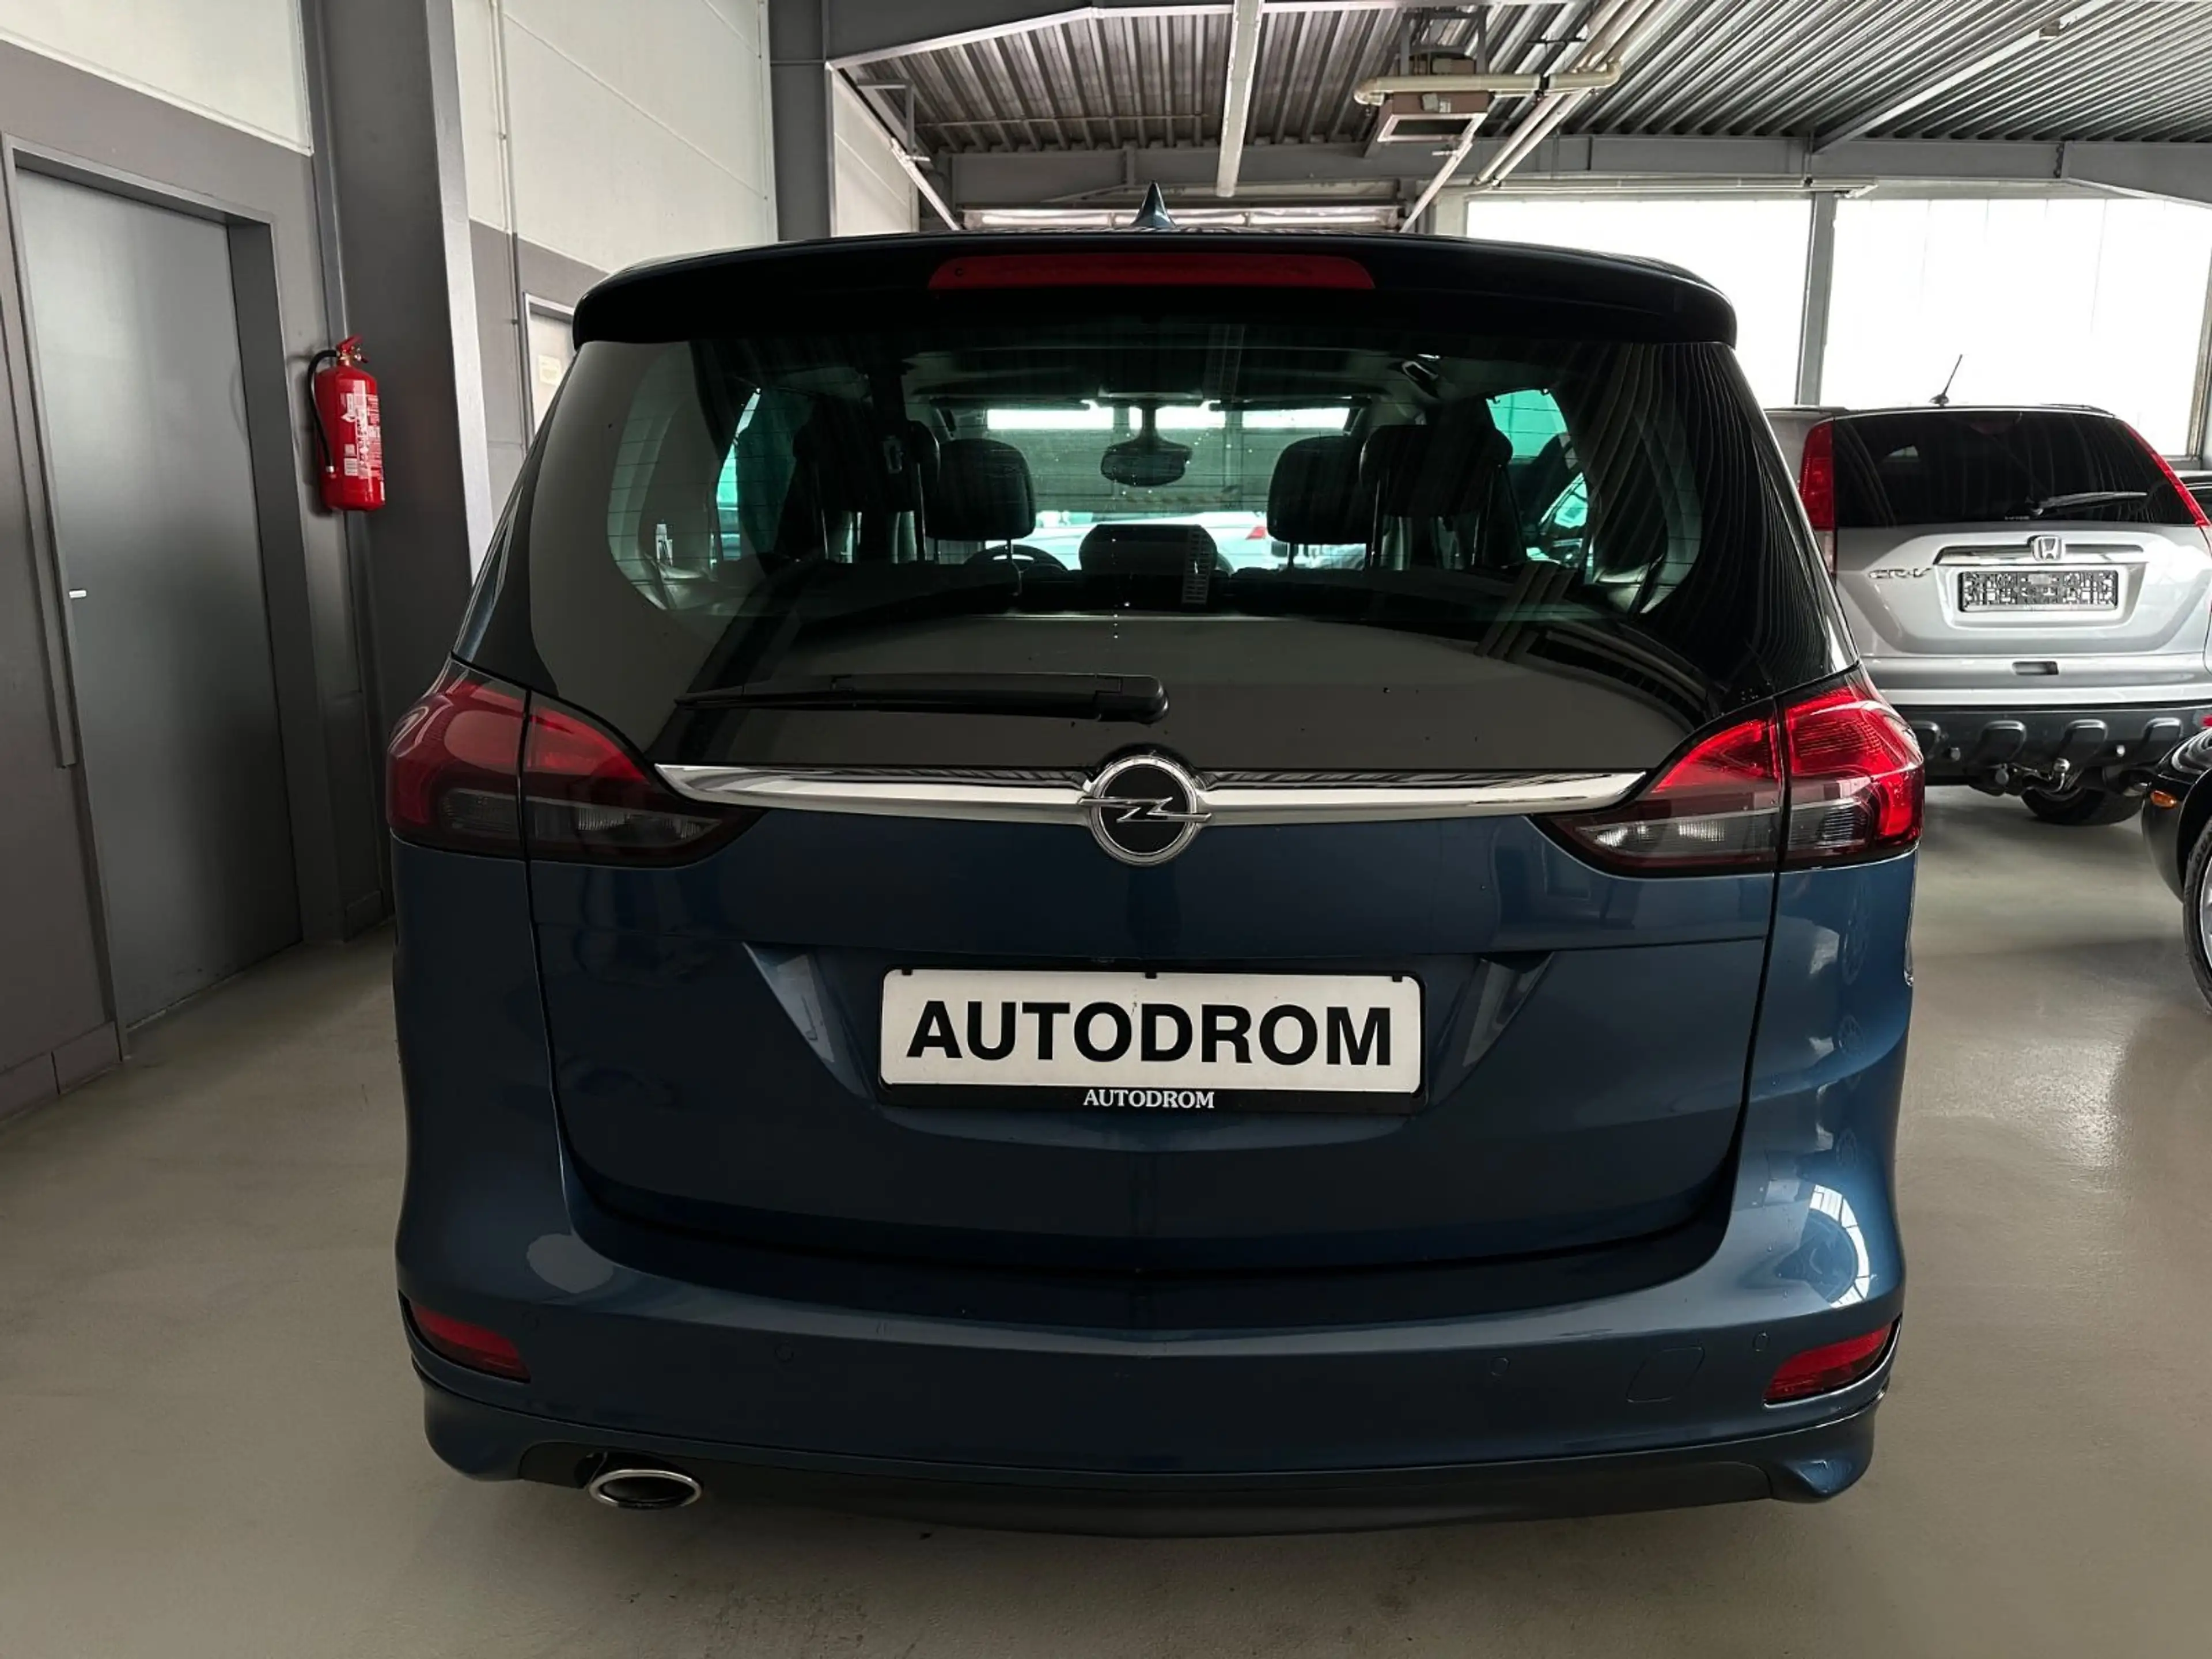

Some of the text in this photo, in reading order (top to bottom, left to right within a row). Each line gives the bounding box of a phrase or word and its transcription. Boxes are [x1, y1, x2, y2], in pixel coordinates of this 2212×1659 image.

[1868, 568, 1932, 579] CR-V
[906, 1001, 1391, 1066] AUTODROM
[1083, 1089, 1215, 1108] AUTODROM
